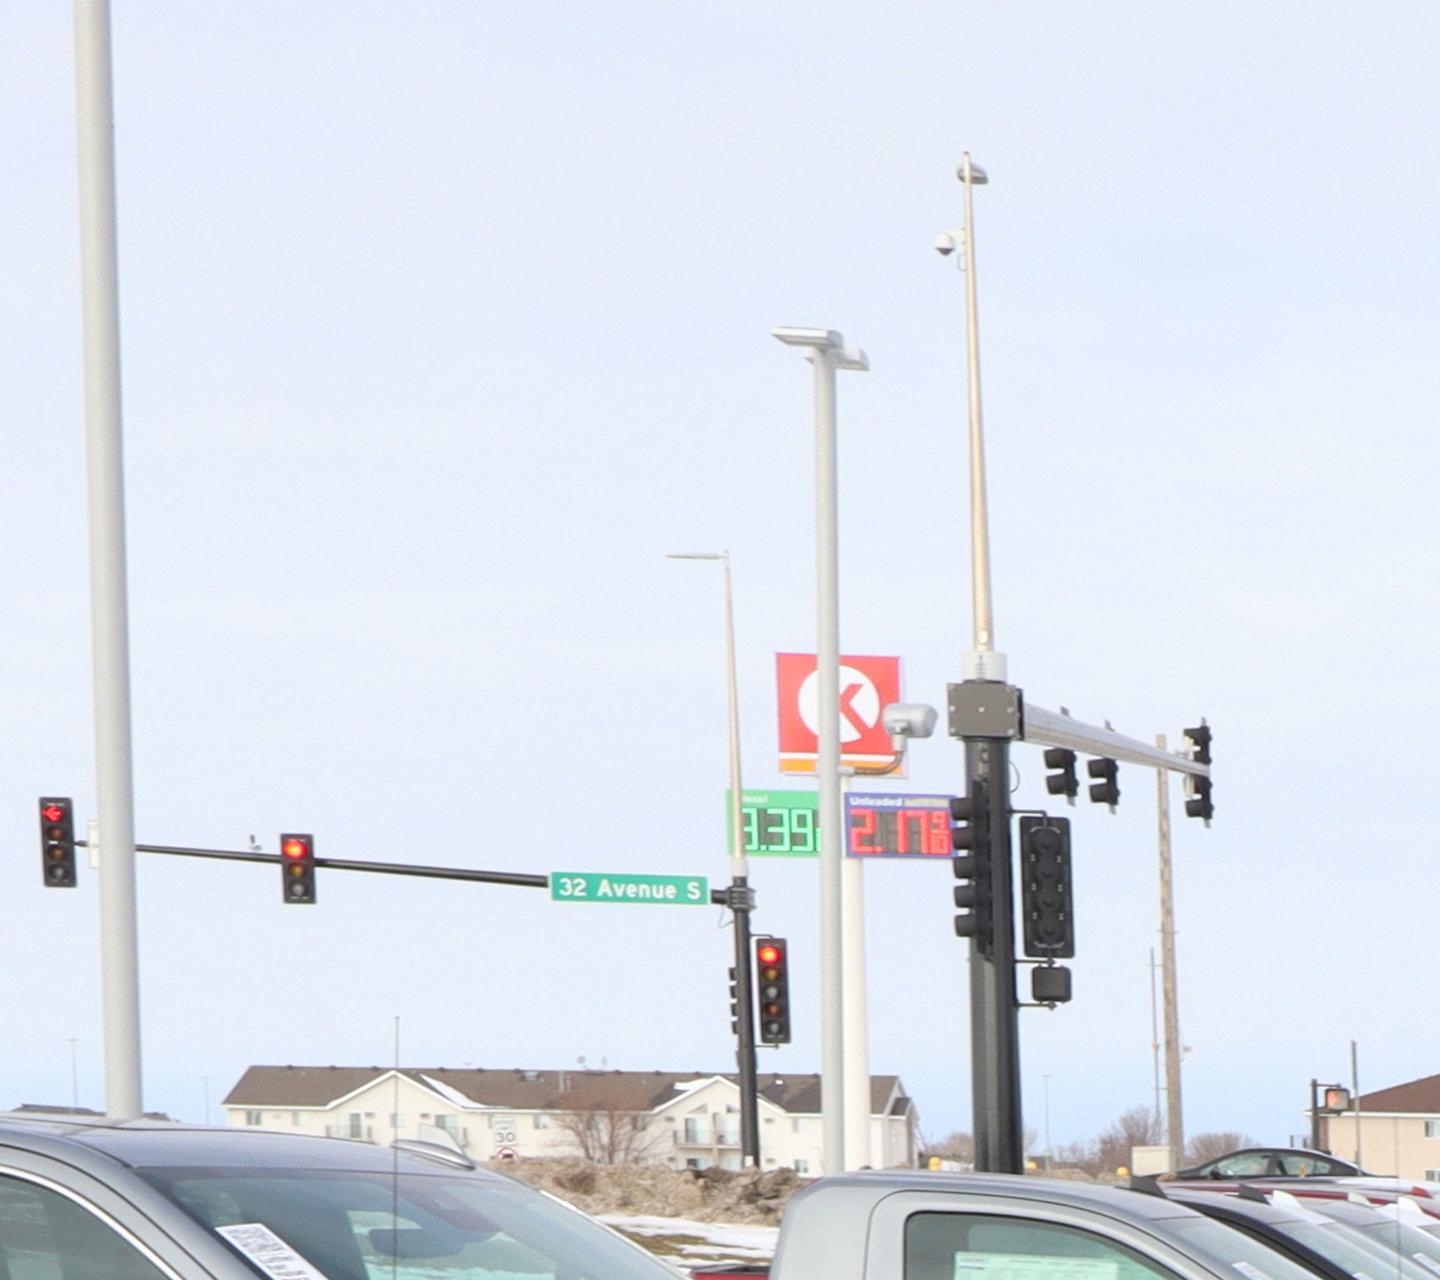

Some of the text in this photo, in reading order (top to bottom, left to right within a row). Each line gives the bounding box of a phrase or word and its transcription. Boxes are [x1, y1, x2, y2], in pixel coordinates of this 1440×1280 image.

[849, 796, 903, 807] Unleaded
[559, 878, 702, 900] 32 Avenue S
[495, 1131, 516, 1144] 30
